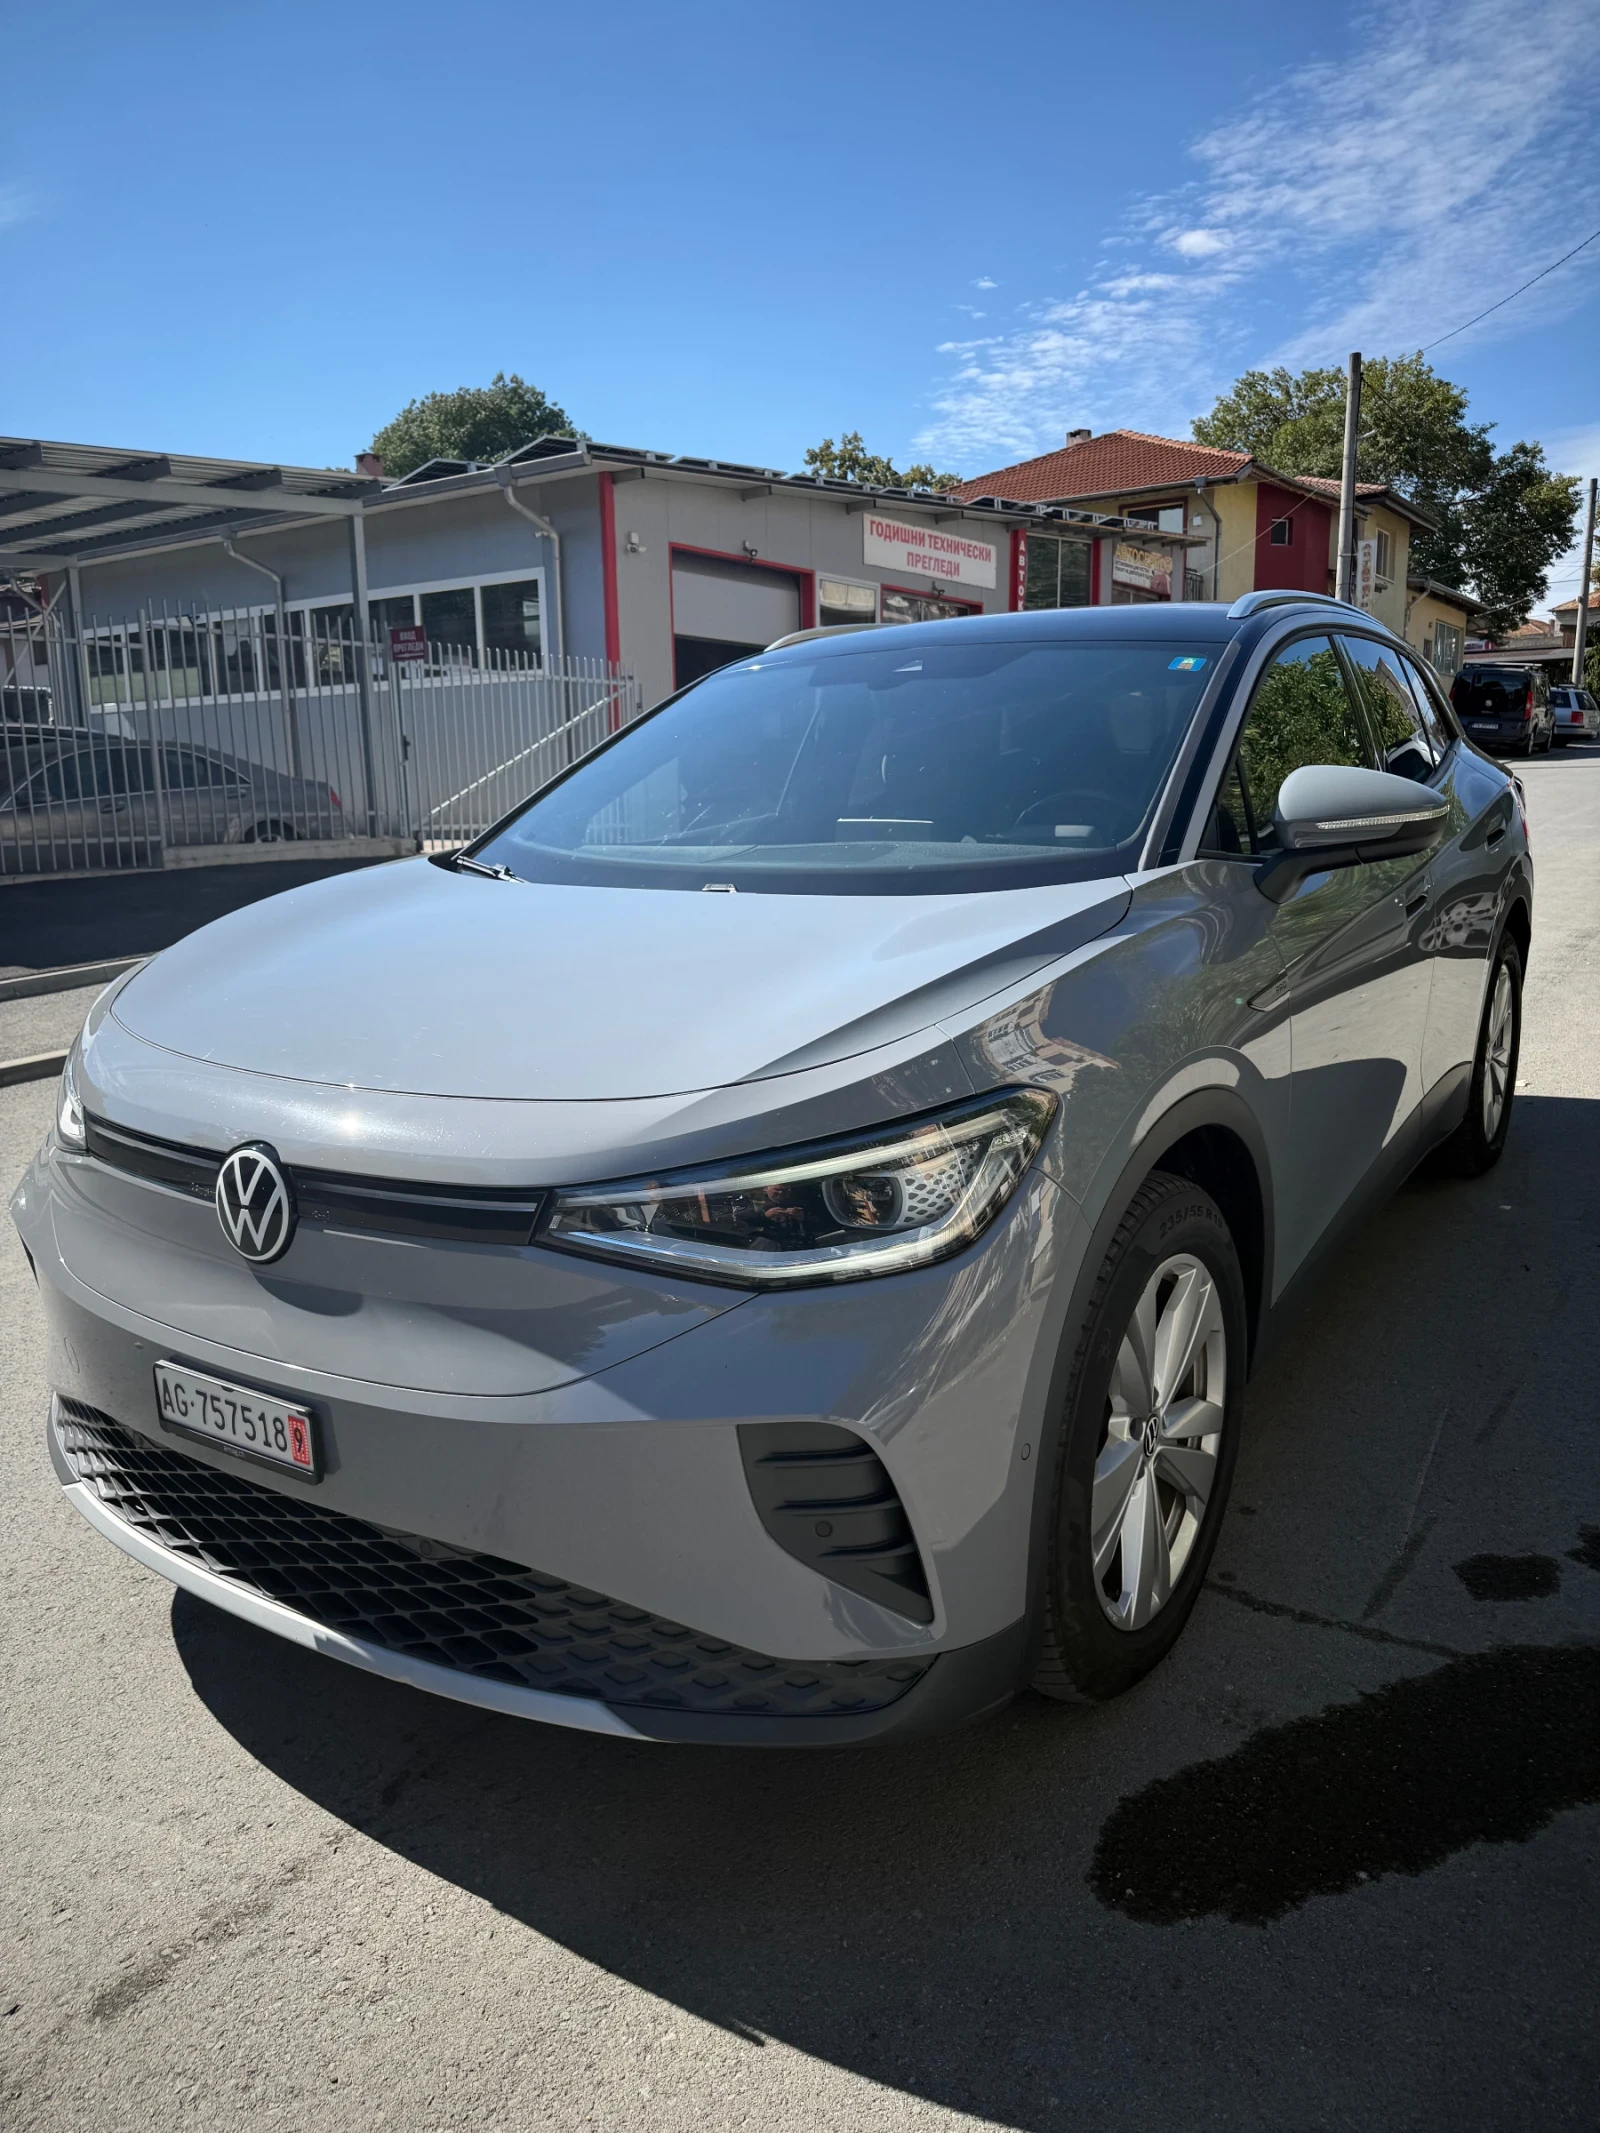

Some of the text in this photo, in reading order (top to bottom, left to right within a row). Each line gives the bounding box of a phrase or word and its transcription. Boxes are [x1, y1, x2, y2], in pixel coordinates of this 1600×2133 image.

[869, 519, 992, 563] ГОДИШНИ ТЕХНИЧЕСКИ
[906, 551, 960, 577] ПРЕГЛЕДИ
